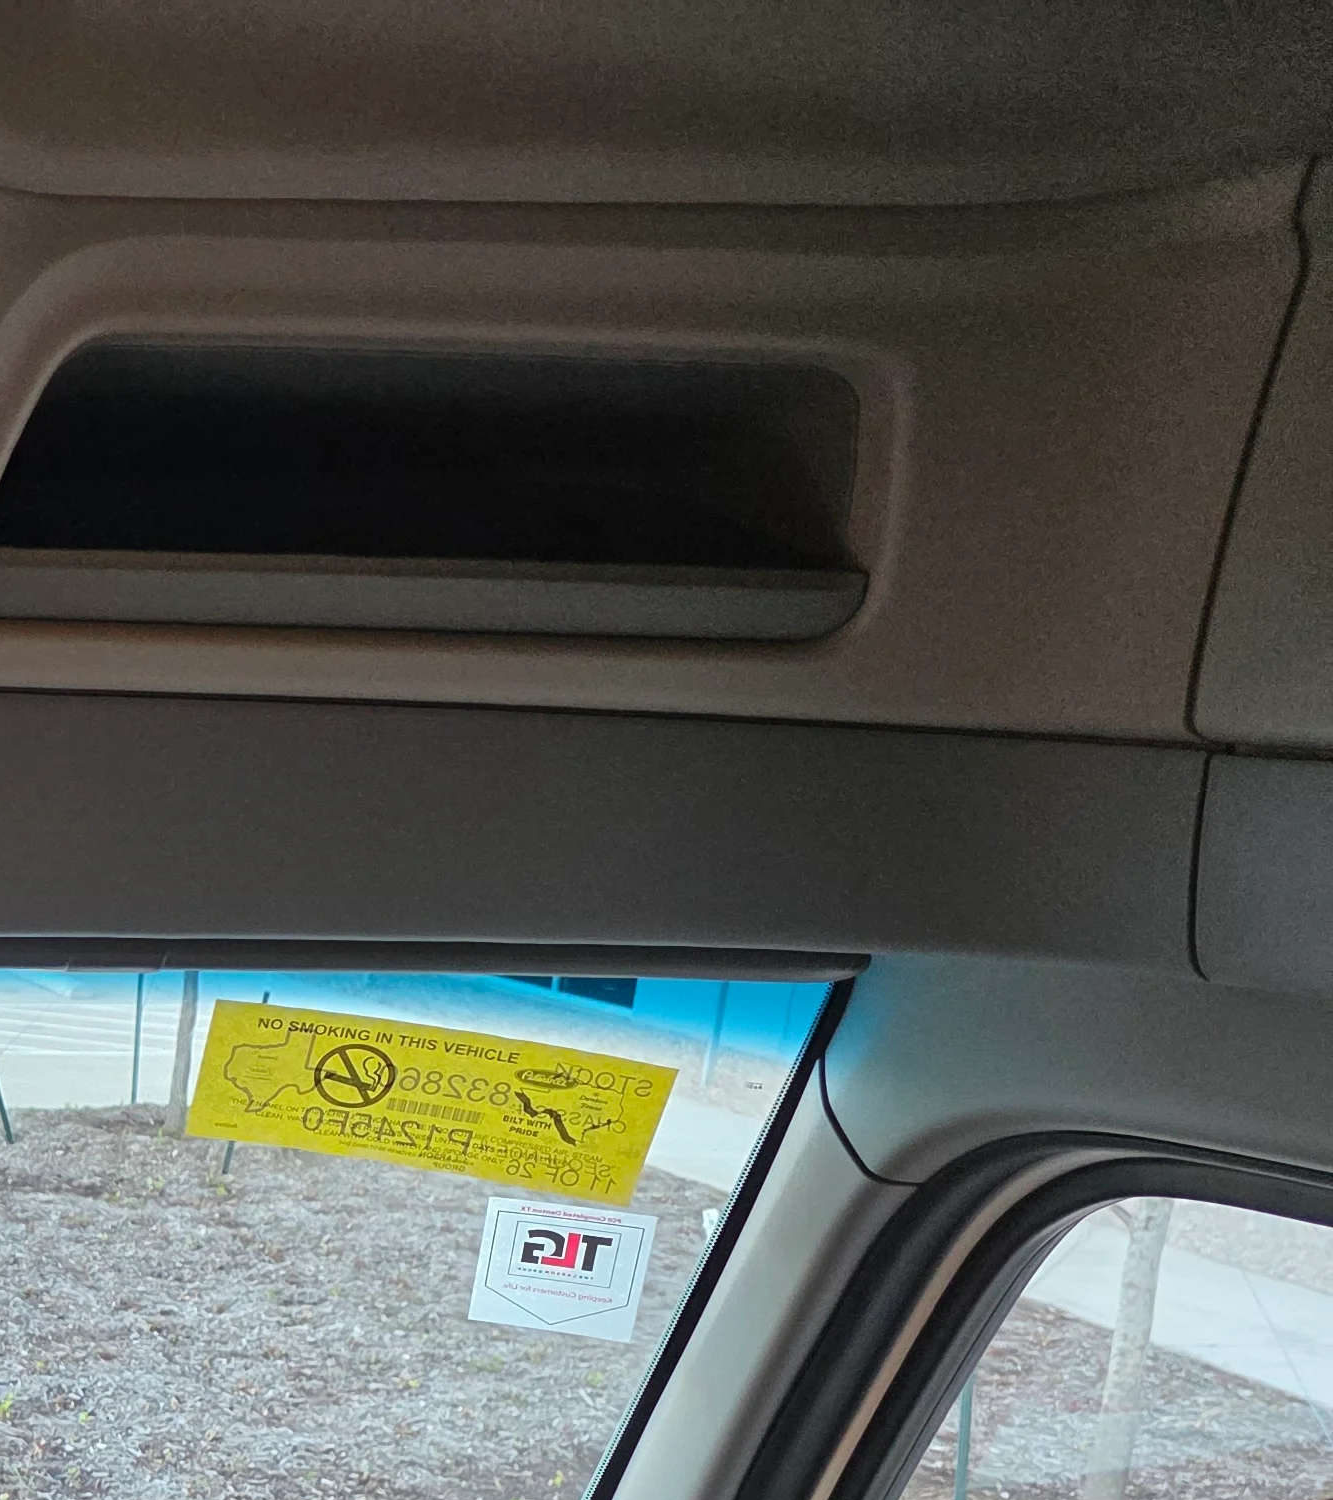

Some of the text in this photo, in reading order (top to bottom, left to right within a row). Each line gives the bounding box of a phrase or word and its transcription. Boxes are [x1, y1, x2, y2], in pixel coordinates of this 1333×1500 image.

[258, 1018, 520, 1064] NO SMOKING IN THIS VEHICLE
[503, 1115, 552, 1131] BILT WITH
[509, 1126, 539, 1138] PRIDE
[490, 1136, 552, 1153] COMPRESSED
